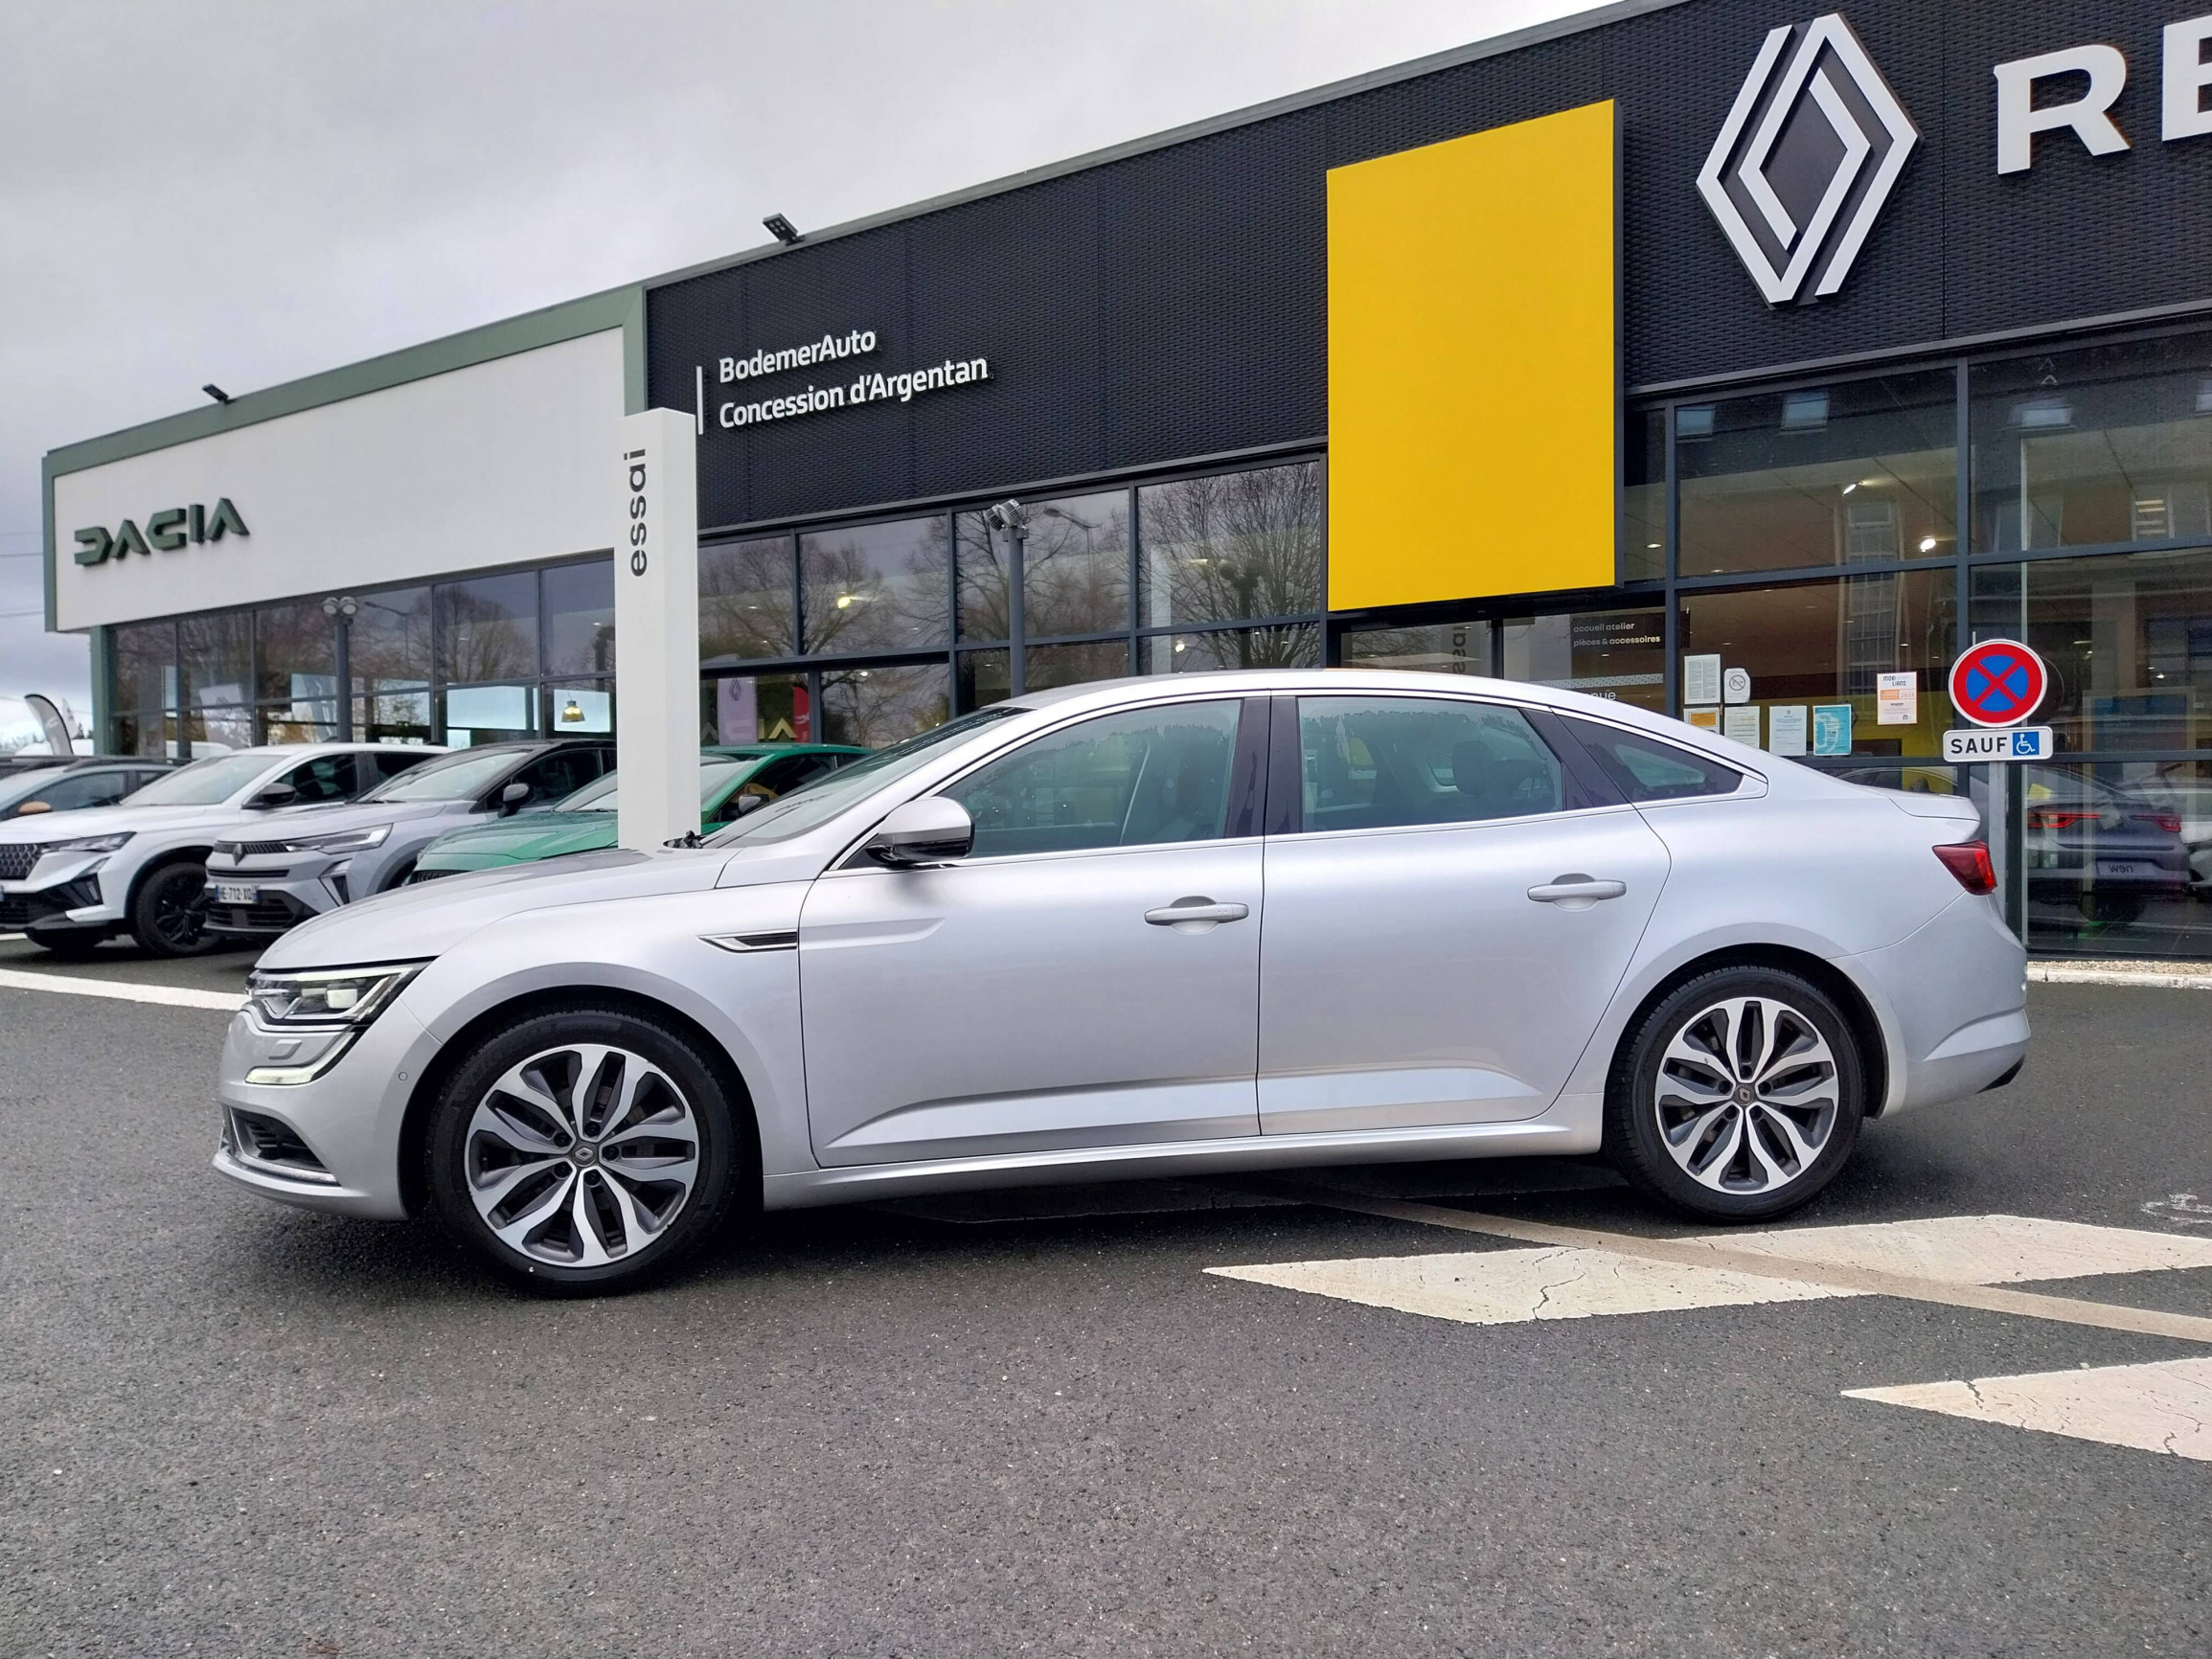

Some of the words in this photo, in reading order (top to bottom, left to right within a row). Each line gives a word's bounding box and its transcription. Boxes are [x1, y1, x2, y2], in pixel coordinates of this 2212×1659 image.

[719, 330, 876, 383] BodemerAuto
[719, 385, 844, 428] Concession
[74, 497, 250, 566] DACIA
[624, 448, 648, 577] essai
[1573, 624, 1605, 632] accueil
[1606, 622, 1635, 631] atelier
[1573, 638, 1601, 648] pièces
[1609, 635, 1660, 645] accessoires
[1950, 737, 2007, 754] SAUF
